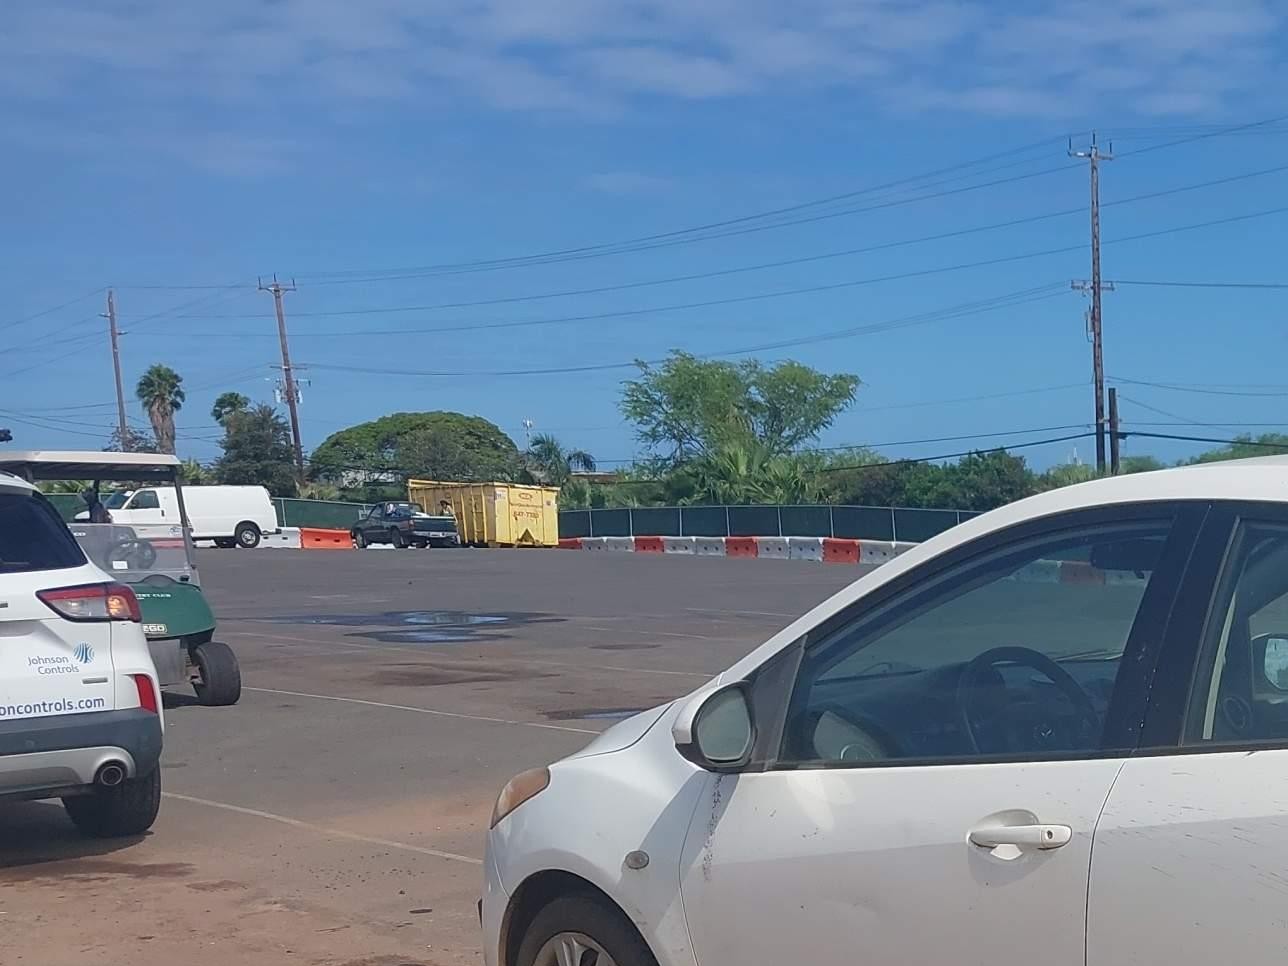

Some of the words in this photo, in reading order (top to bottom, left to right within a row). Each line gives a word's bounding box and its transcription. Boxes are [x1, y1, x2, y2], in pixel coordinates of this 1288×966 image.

[28, 656, 69, 666] Johnson
[38, 664, 80, 675] Controls
[0, 697, 105, 716] oncontrols.com
